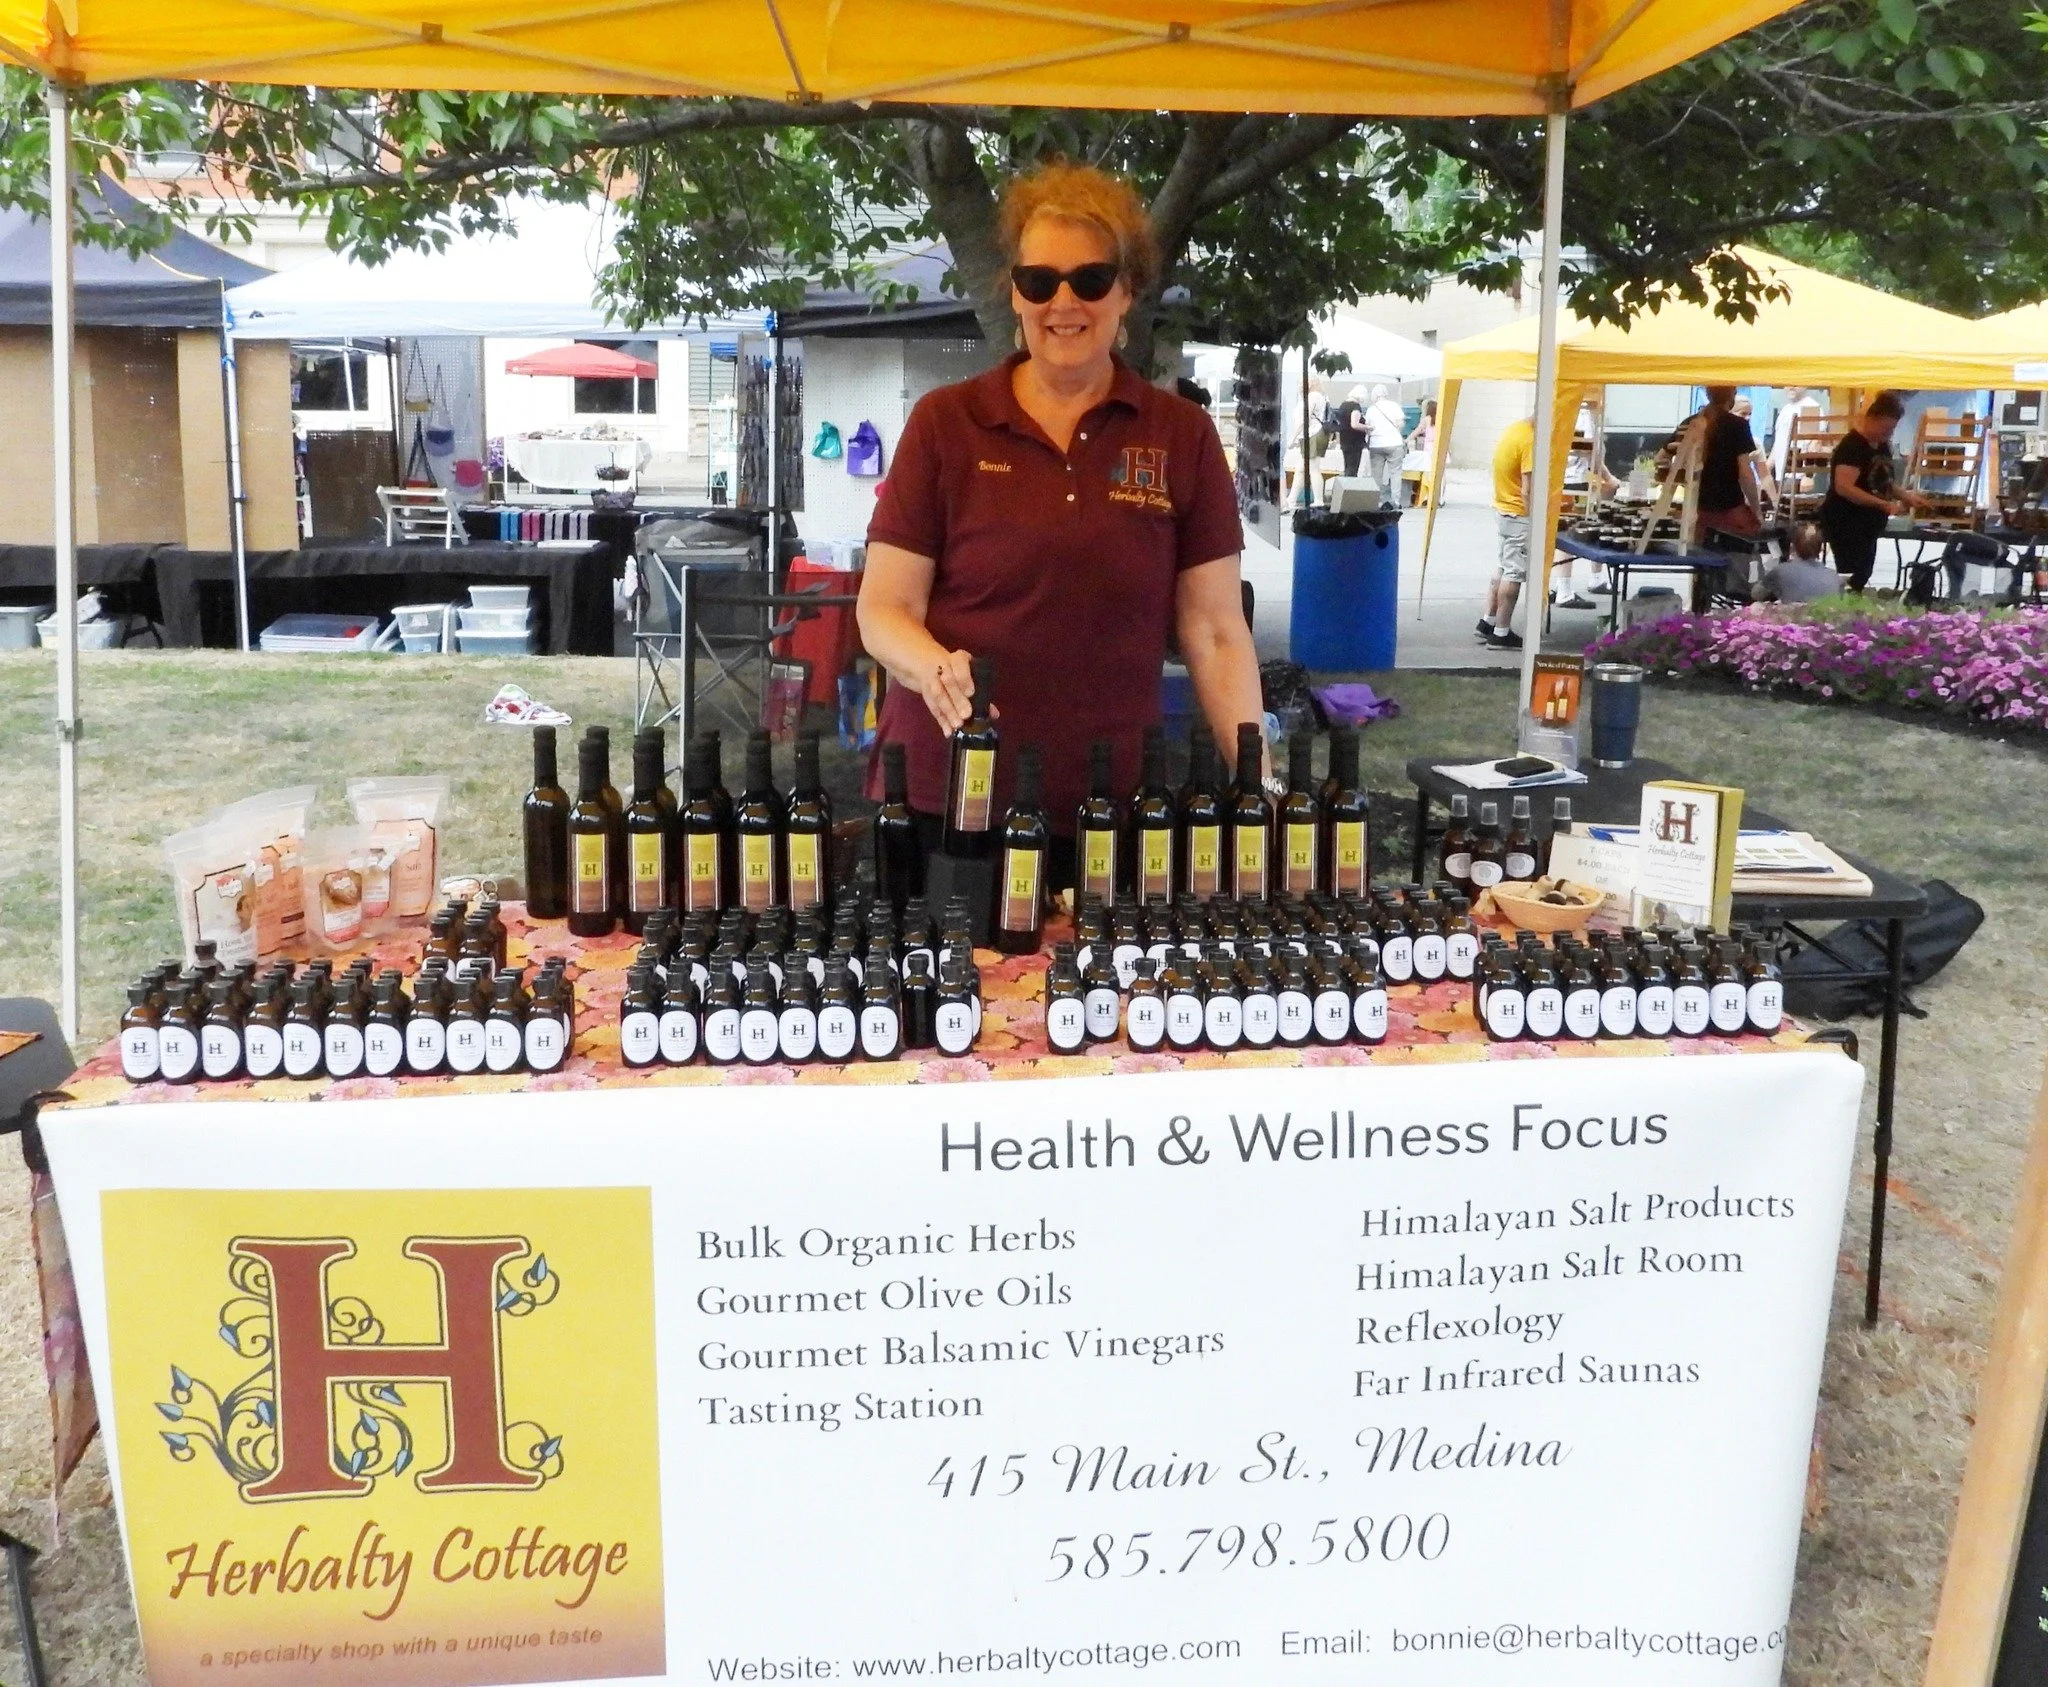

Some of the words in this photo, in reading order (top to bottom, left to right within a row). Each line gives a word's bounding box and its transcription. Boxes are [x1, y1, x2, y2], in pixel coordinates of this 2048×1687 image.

[978, 460, 1012, 472] Bonnie
[1121, 447, 1167, 492] H
[1659, 799, 1697, 846] H
[942, 1119, 1134, 1172] Health
[1158, 1116, 1210, 1165] &
[1227, 1111, 1489, 1163] Wellness
[1513, 1104, 1667, 1151] Focus
[1363, 1200, 1555, 1240] Himalayan
[1570, 1191, 1631, 1226] Salt
[1645, 1185, 1793, 1220] Products
[697, 1225, 784, 1259] Bulk
[800, 1224, 953, 1267] Organic
[970, 1217, 1075, 1252] Herbs
[1357, 1254, 1548, 1293] Himalayan
[1563, 1244, 1624, 1278] Salt
[1640, 1247, 1742, 1273] Room
[697, 1287, 866, 1314] Gourmet
[881, 1276, 983, 1309] Olive
[998, 1272, 1071, 1306] Oils
[1357, 1304, 1563, 1344] Reflexology
[228, 1235, 545, 1504] H
[699, 1343, 867, 1370] Gourmet
[885, 1330, 1049, 1364] Balsamic
[1066, 1328, 1223, 1365] Vinegars
[1356, 1371, 1409, 1396] Far
[1422, 1352, 1563, 1391] Infrared
[1580, 1356, 1699, 1383] Saunas
[699, 1393, 841, 1432] Tasting
[855, 1389, 982, 1420] Station
[928, 1454, 1026, 1498] 415
[1052, 1443, 1219, 1493] Main
[1240, 1432, 1328, 1482] St.,
[1355, 1422, 1571, 1474] Medina
[1045, 1513, 1450, 1582] 585.798.5800
[166, 1520, 413, 1621] Herbalty
[433, 1526, 628, 1610] Cottage
[200, 1653, 213, 1668] a
[222, 1643, 322, 1670] specialty
[329, 1641, 384, 1663] shop
[393, 1637, 436, 1656] with
[445, 1639, 458, 1652] a
[466, 1633, 540, 1652] unique
[550, 1627, 602, 1646] taste
[708, 1657, 839, 1681] Website:
[853, 1640, 1240, 1676] www.herbaltycottage.com
[1282, 1630, 1371, 1656] Email:
